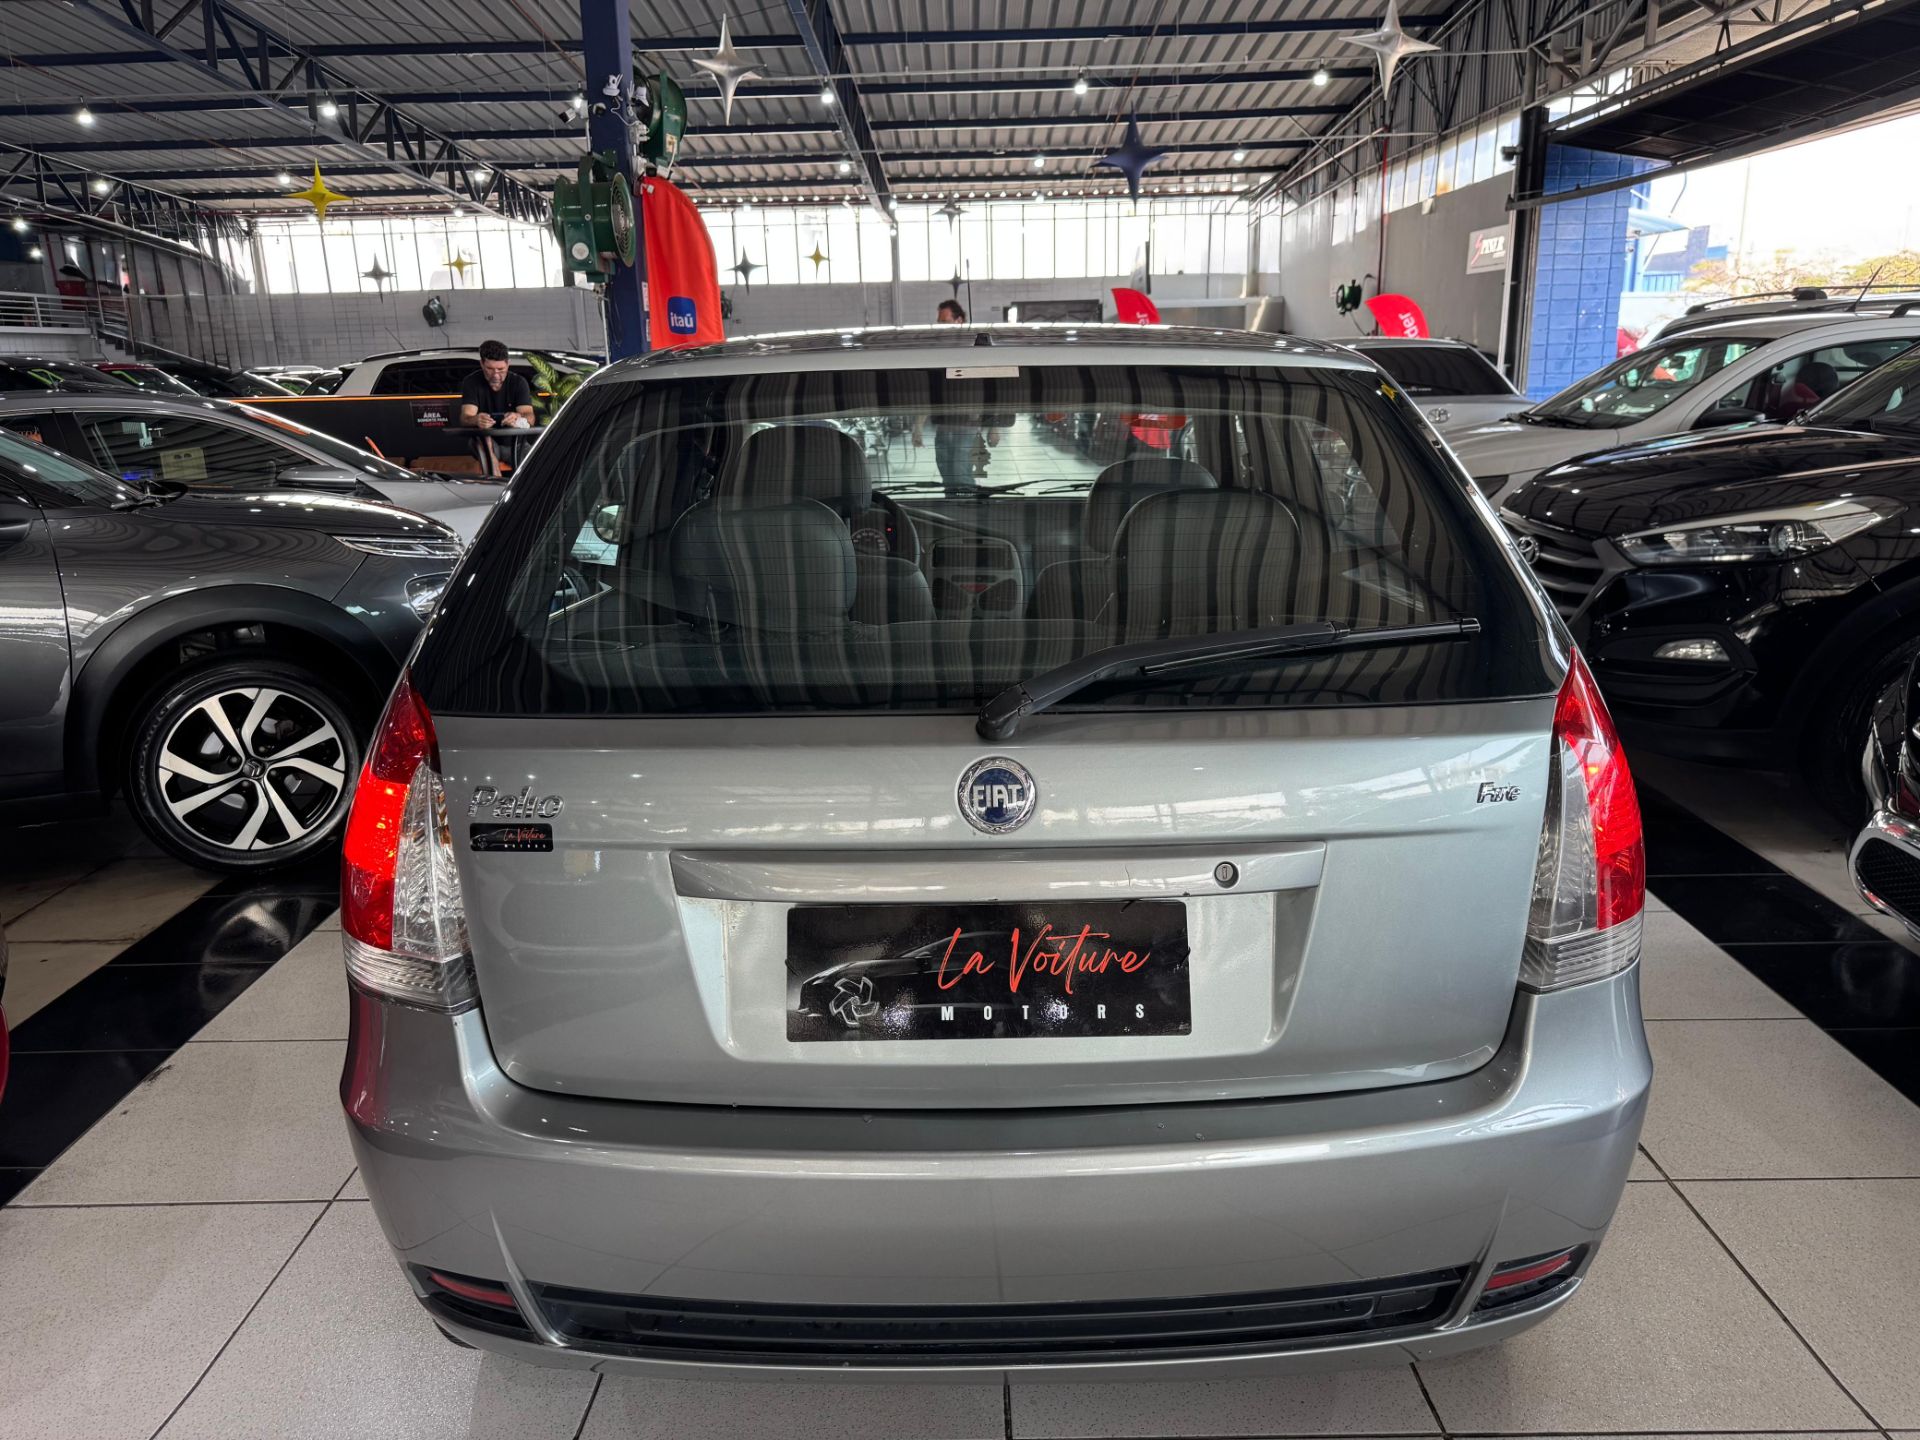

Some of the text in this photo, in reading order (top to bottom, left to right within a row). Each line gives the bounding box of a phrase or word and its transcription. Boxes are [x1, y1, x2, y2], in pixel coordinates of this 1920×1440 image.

[670, 312, 694, 328] itaú
[467, 785, 564, 818] Palio
[972, 784, 1022, 811] FIAT
[937, 923, 1151, 995] La Voiture
[941, 1003, 1145, 1021] MOTORS
